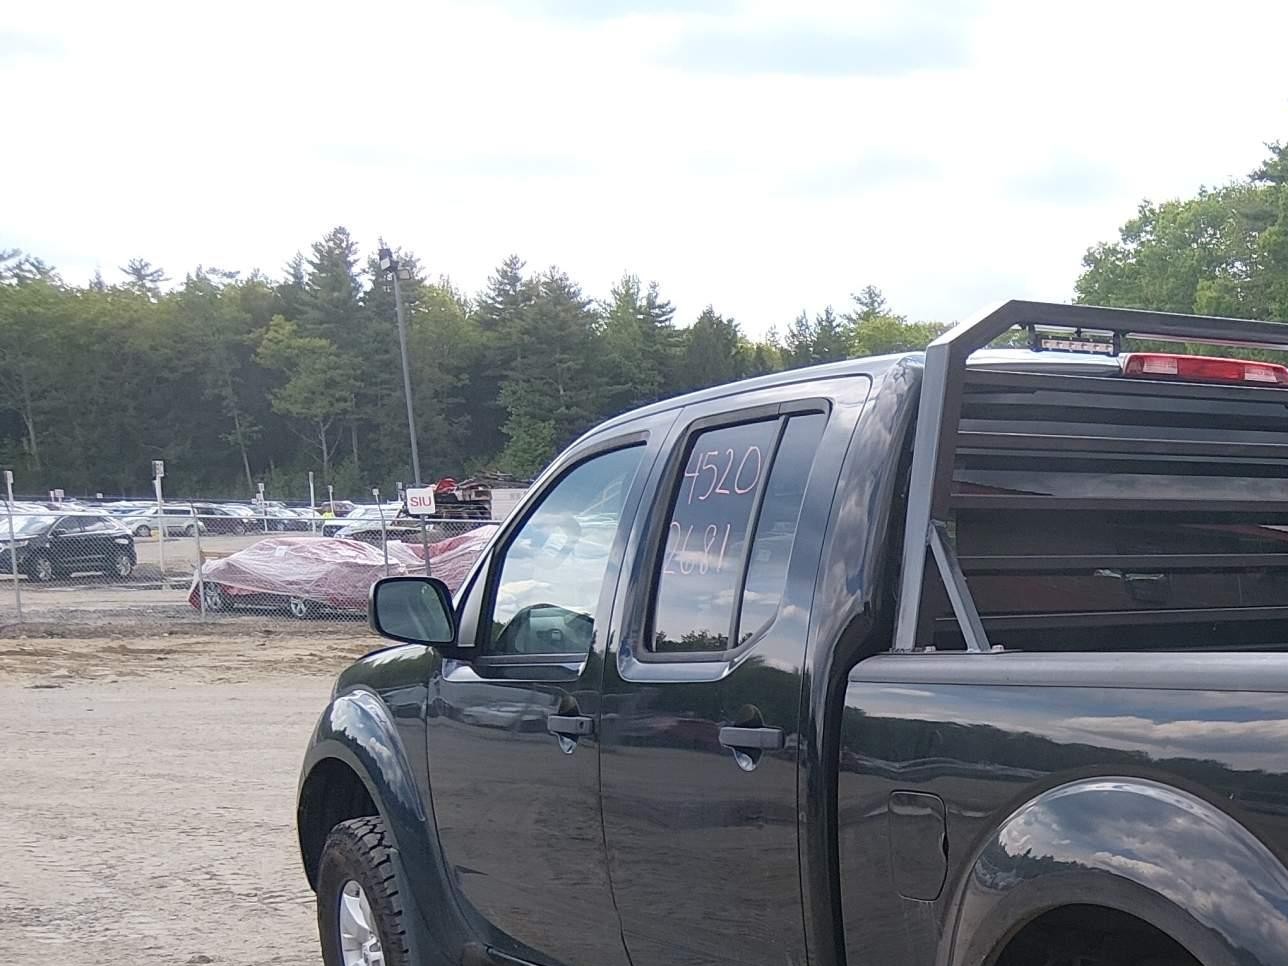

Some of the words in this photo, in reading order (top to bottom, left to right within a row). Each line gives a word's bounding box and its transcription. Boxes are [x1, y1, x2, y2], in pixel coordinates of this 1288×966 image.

[410, 496, 432, 507] SIU
[684, 446, 761, 505] 4520
[663, 521, 731, 575] 2681
